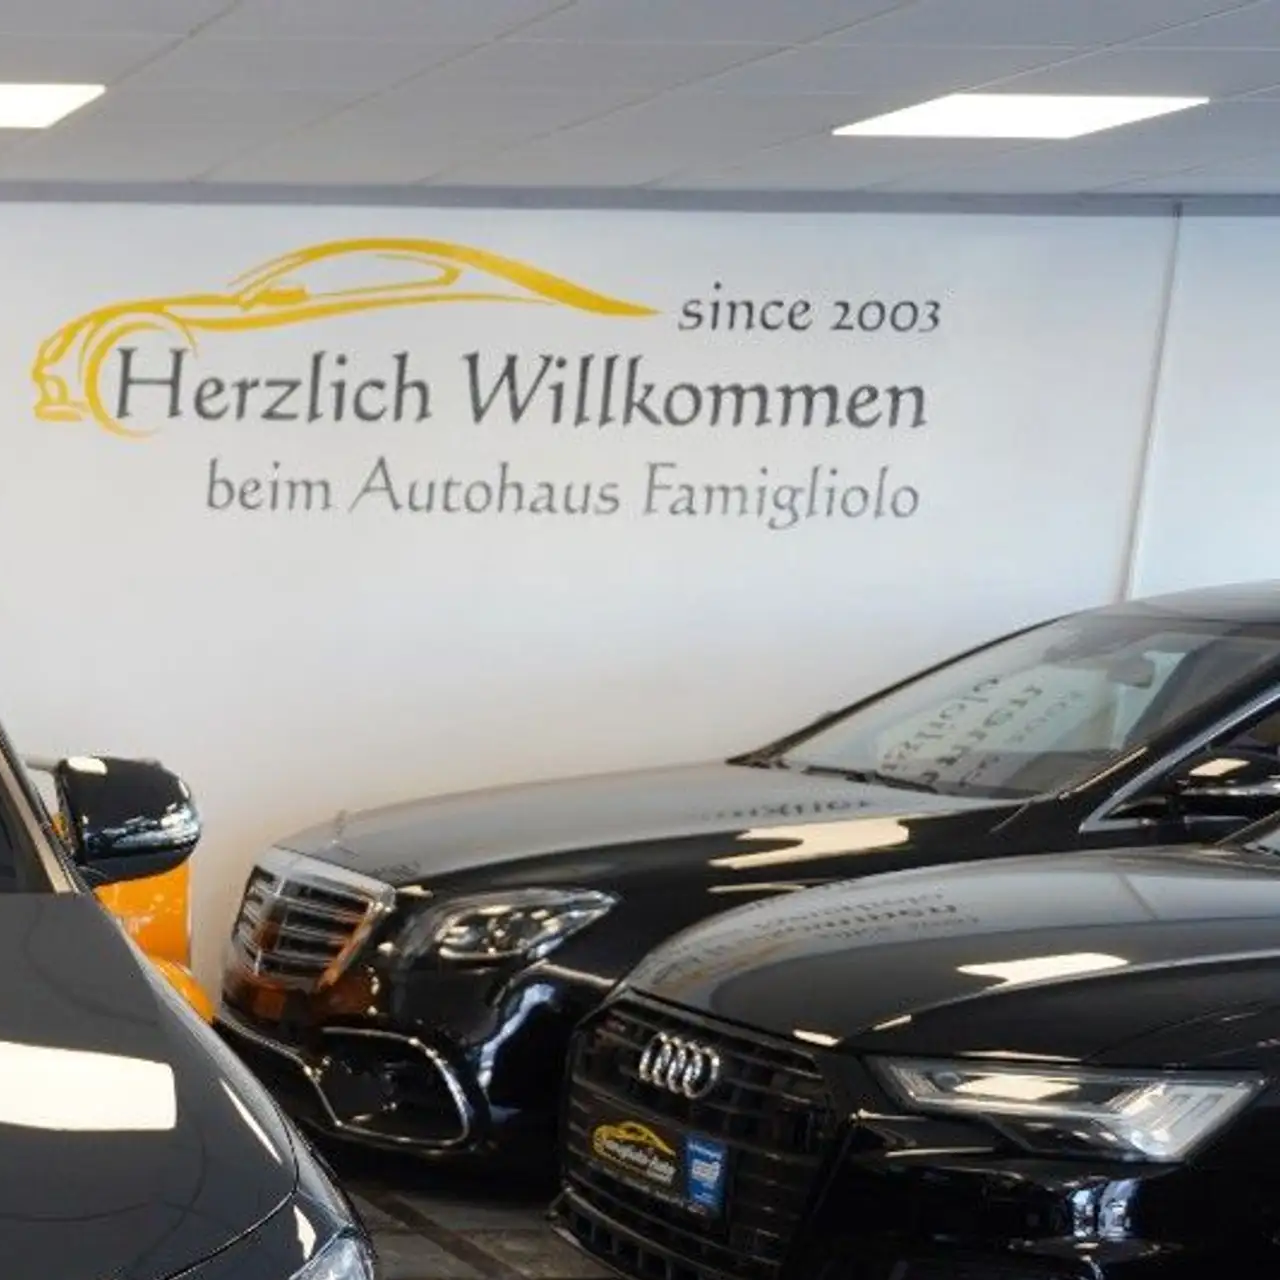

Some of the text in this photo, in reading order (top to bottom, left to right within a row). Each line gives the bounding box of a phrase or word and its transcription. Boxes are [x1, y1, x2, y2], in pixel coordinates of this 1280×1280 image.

[678, 281, 942, 333] since 2003
[116, 347, 927, 429] Herzlich Willkommen
[206, 455, 921, 531] beim Autohaus Famigliolo
